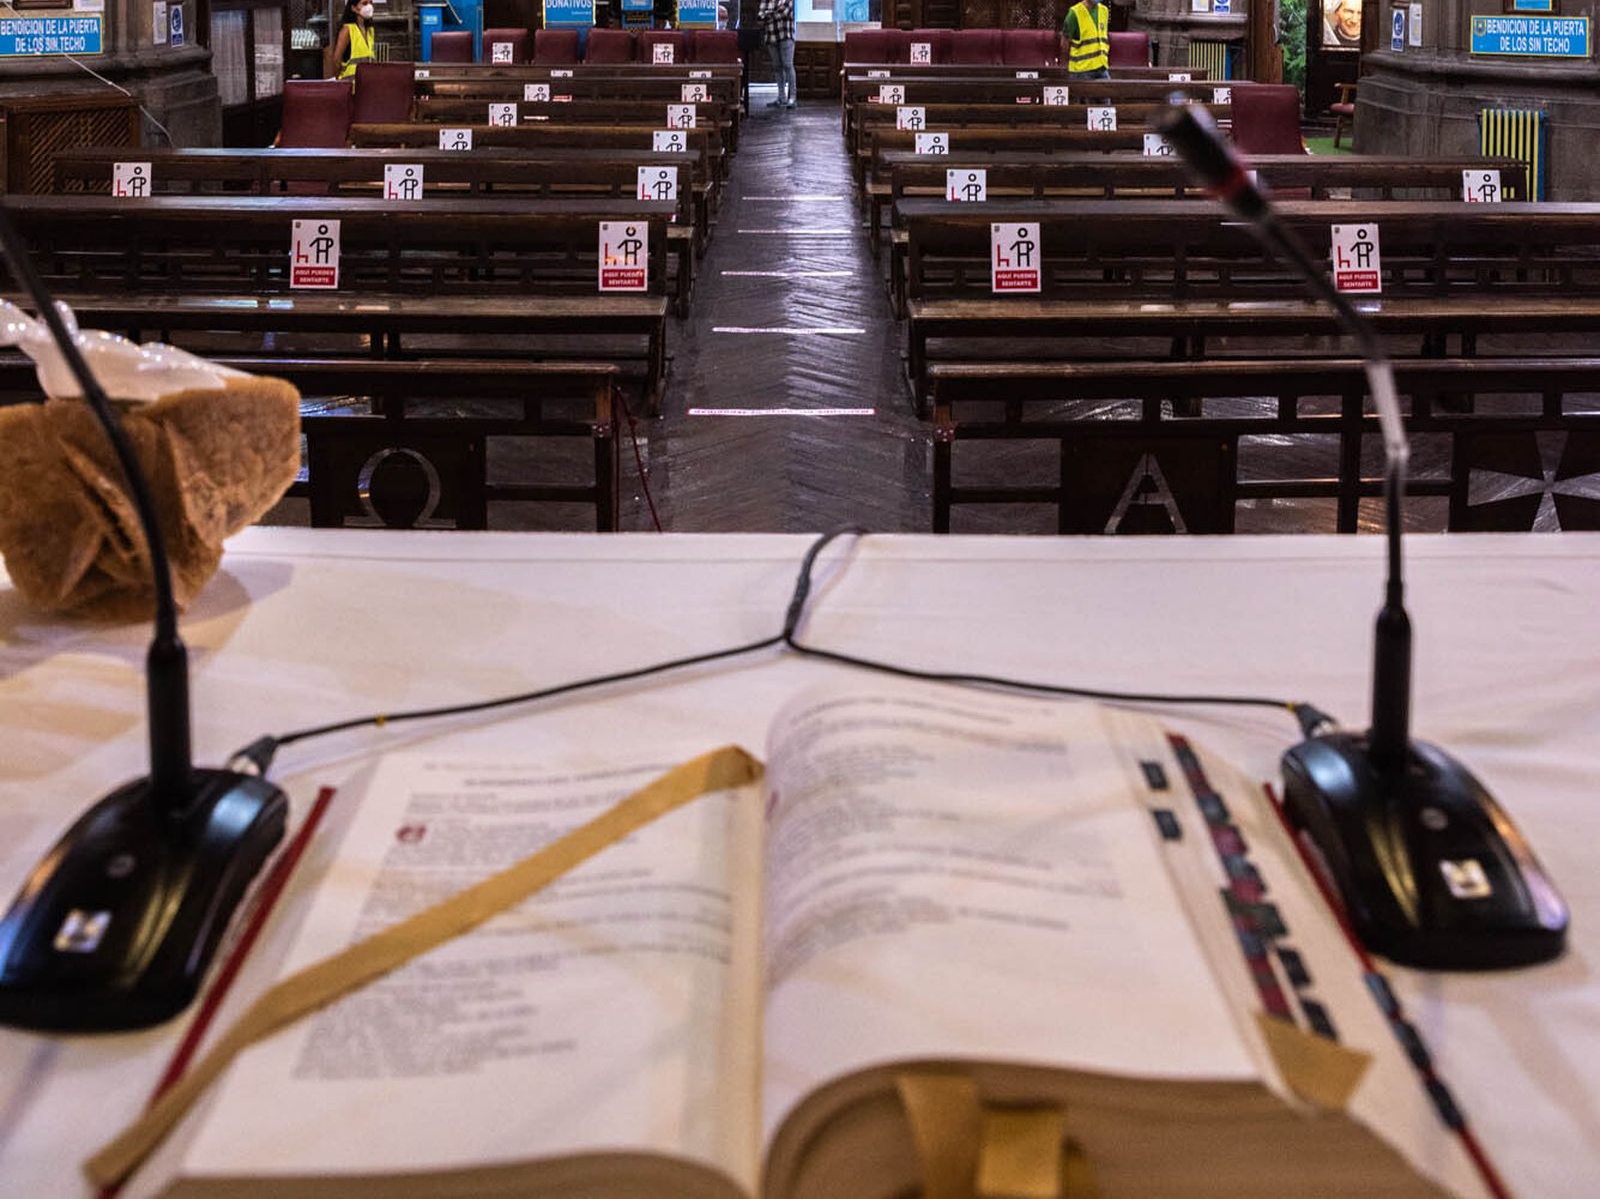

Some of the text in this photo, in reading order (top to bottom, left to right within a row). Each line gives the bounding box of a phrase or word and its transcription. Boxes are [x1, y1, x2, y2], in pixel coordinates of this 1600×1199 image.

[1, 19, 99, 35] BENDICION DE LA PUERTA
[1487, 19, 1585, 35] BENDICION DE LA PUERTA
[15, 36, 86, 52] DE LOS SIN TECHO
[1500, 36, 1570, 53] DE LOS SIN TECHO
